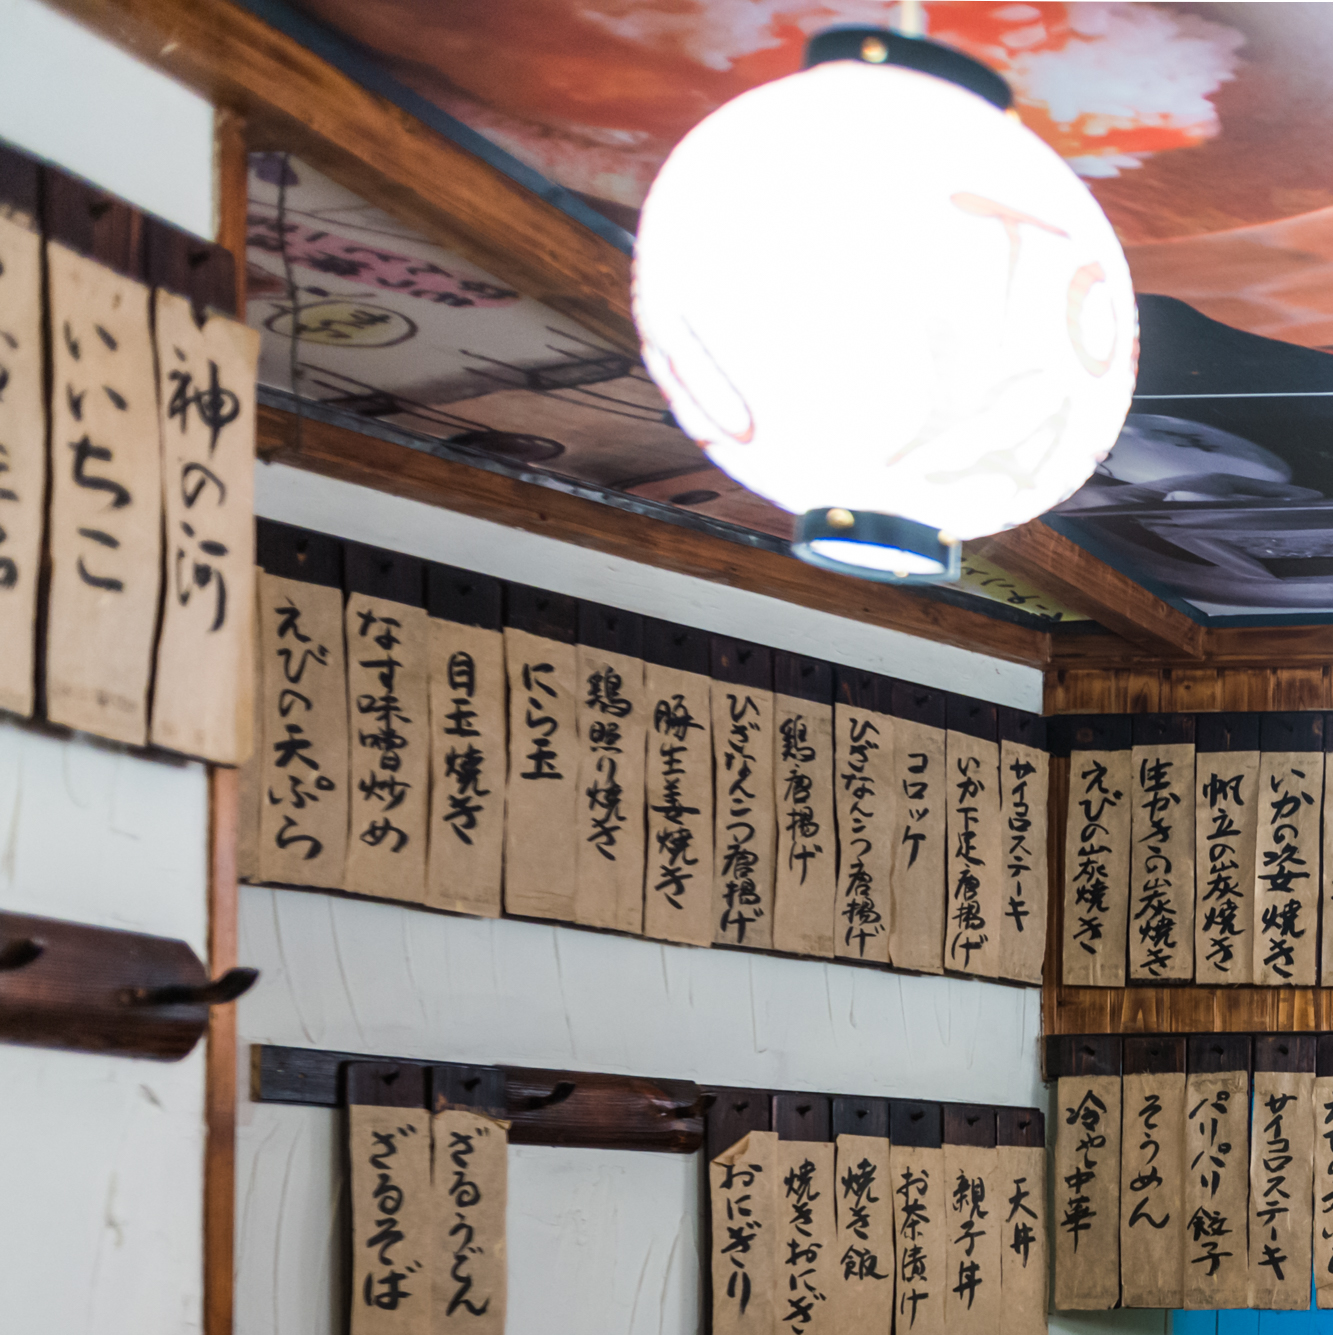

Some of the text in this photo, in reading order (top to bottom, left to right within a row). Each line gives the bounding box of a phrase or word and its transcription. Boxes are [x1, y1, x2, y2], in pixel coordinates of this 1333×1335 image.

[66, 326, 131, 591] いいちこ
[169, 350, 240, 631] 神の河
[269, 599, 335, 860] えびの天ぷら
[357, 610, 412, 853] なす味噌炒め
[443, 651, 490, 845] 目玉焼き
[521, 663, 563, 780] にら玉
[902, 753, 929, 869] コロッケ
[1251, 769, 1321, 986] いかの姿焼き
[363, 1124, 422, 1310] ざるそば
[446, 1128, 489, 1316] ざるうどん
[713, 1157, 762, 1314] おにぎり
[841, 1158, 888, 1280] 焼き飯
[896, 1166, 930, 1329] お茶漬け
[1061, 1090, 1107, 1253] 冷やし中華
[1129, 1095, 1170, 1229] そうめん
